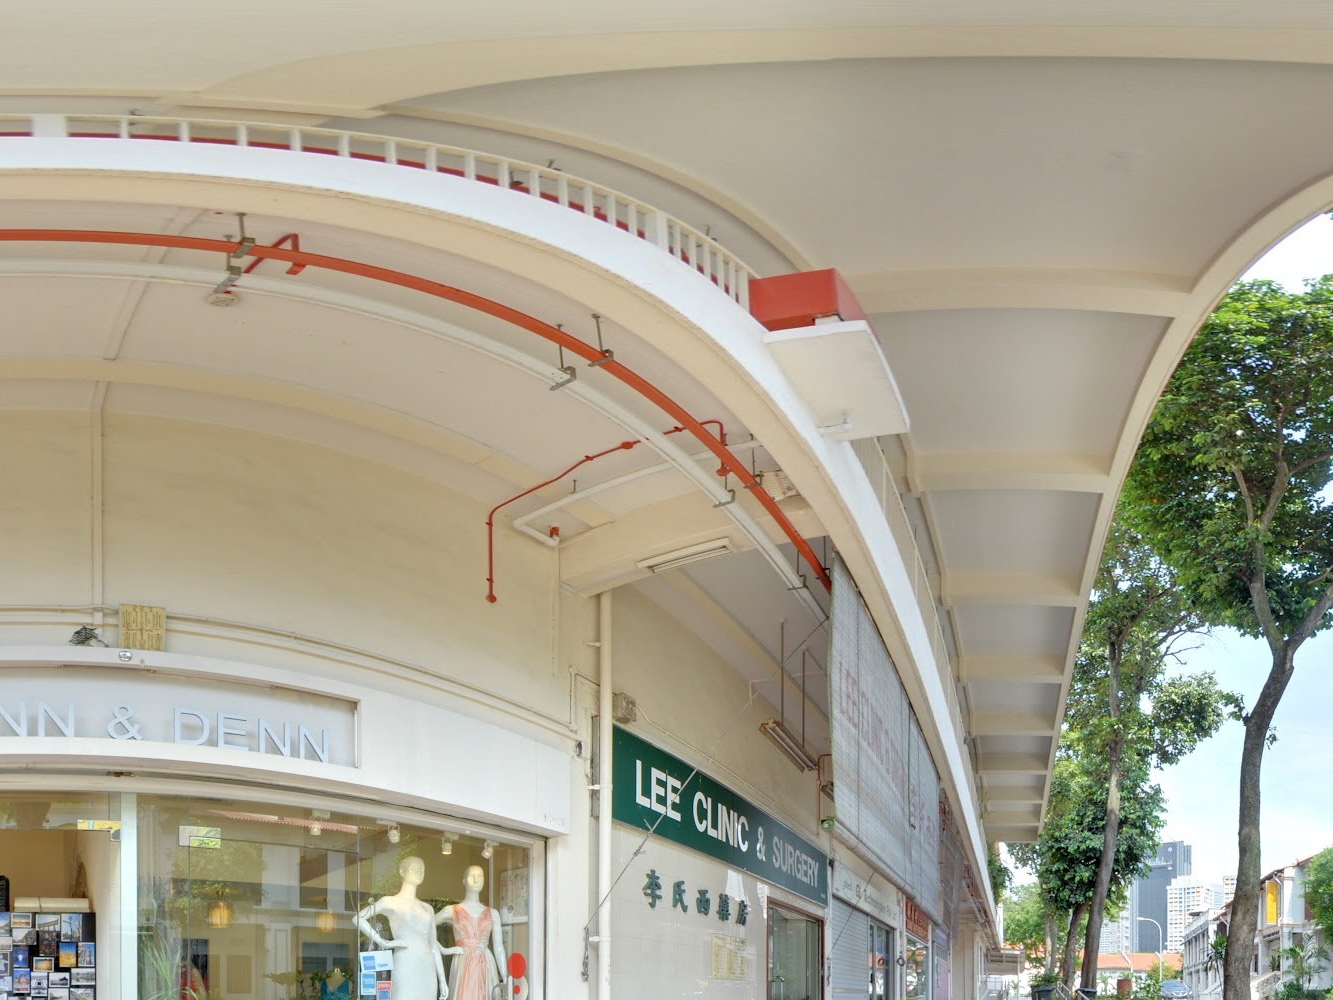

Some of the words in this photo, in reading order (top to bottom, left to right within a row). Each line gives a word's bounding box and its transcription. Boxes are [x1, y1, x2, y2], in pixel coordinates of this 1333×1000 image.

[106, 704, 144, 741] &
[172, 706, 331, 764] DENN
[635, 758, 682, 822] LEE
[693, 791, 749, 853] CLINIC
[756, 826, 766, 862] &
[772, 835, 819, 888] SURGERY
